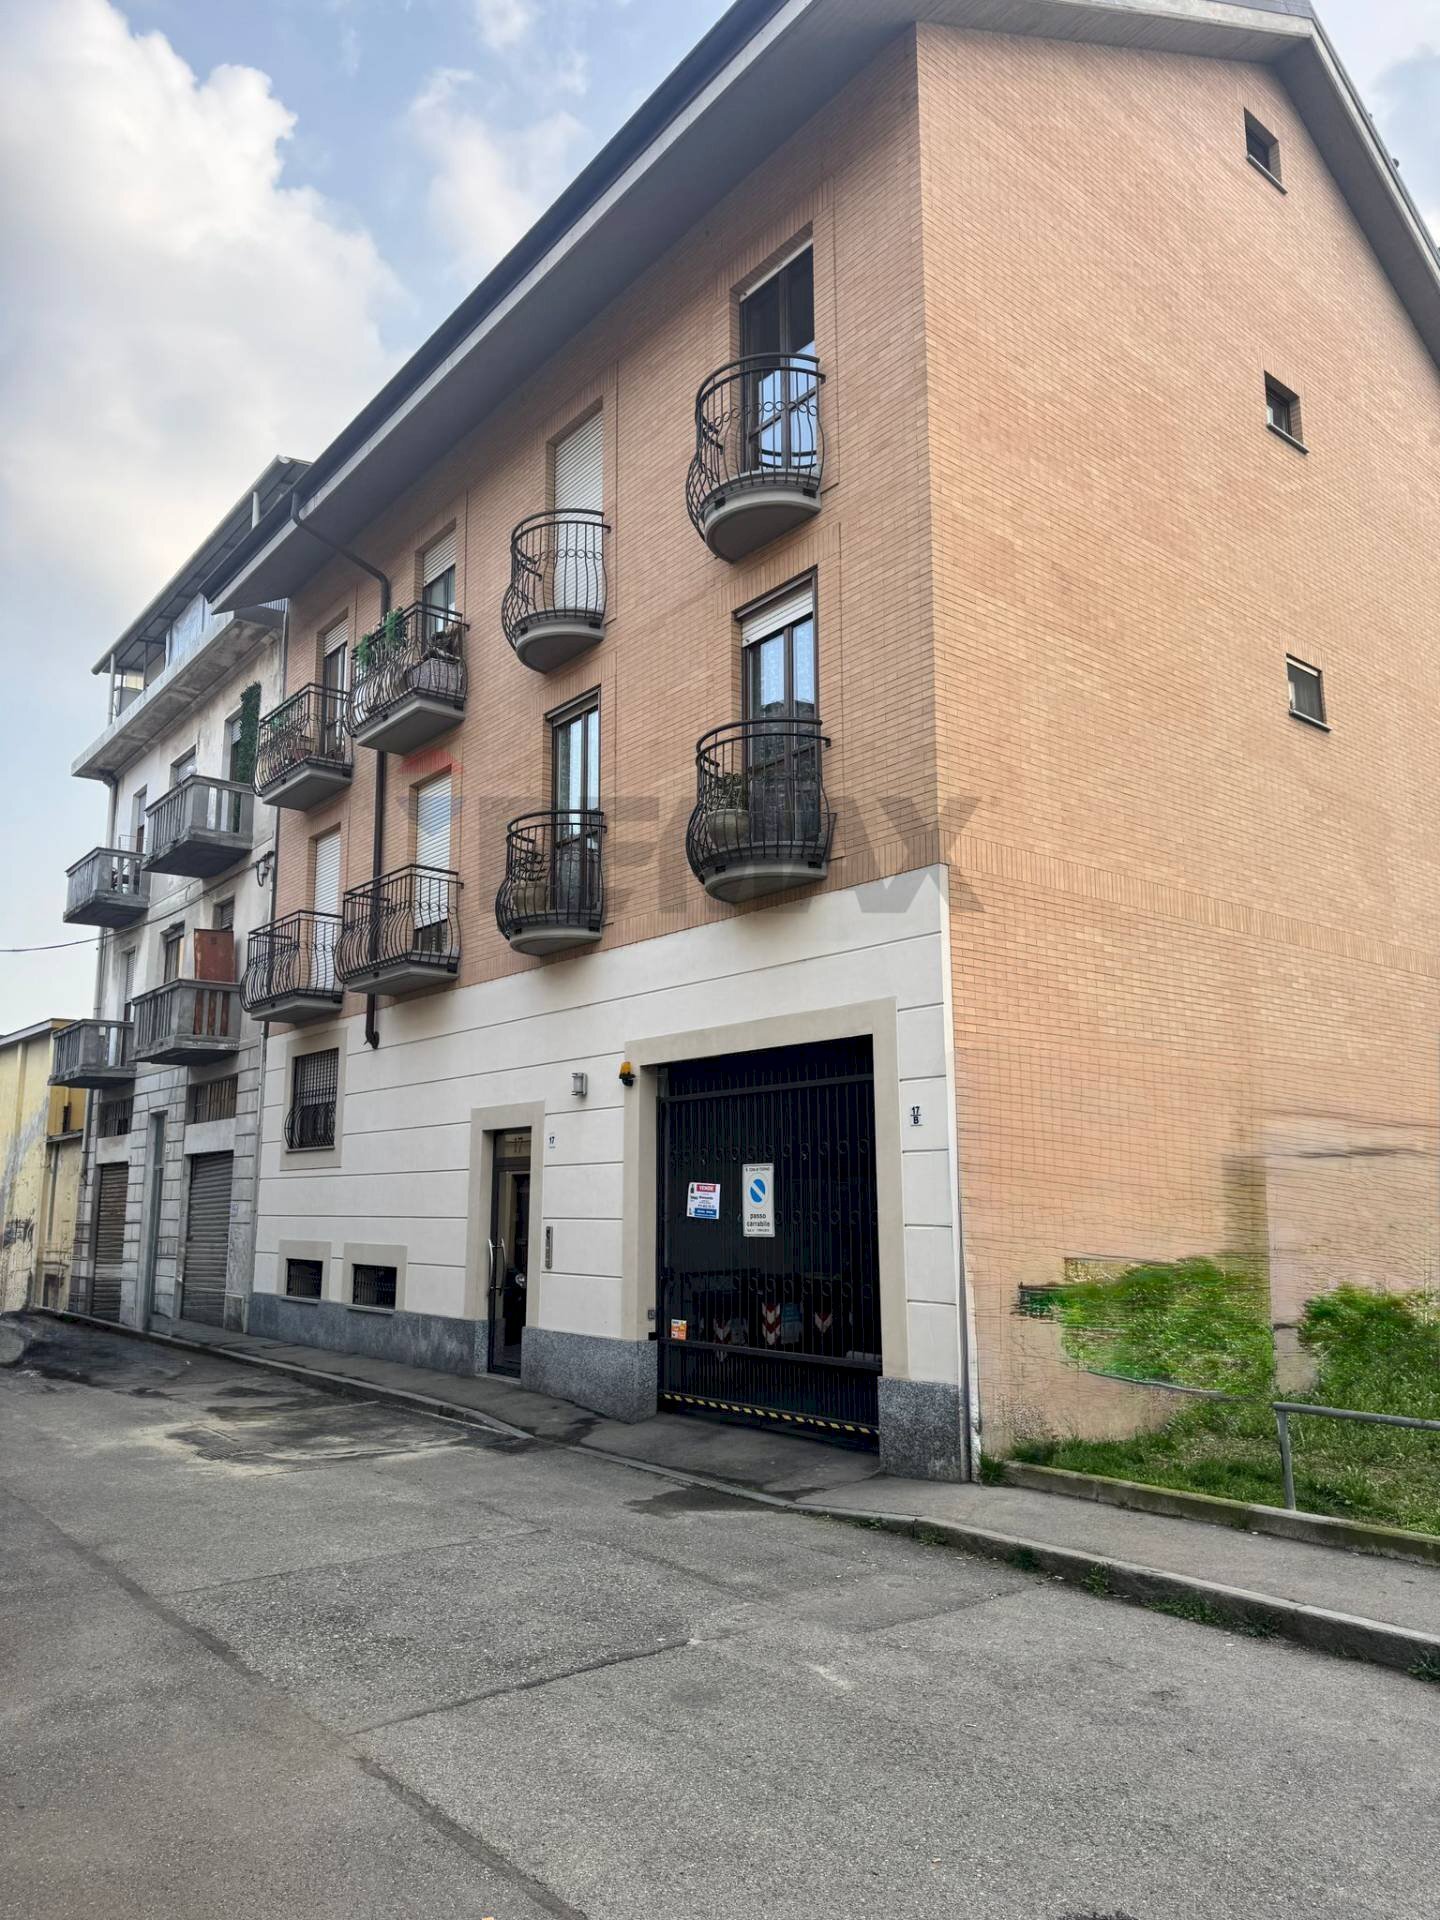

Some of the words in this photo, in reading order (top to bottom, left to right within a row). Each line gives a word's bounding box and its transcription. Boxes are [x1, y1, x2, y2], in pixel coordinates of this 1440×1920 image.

[911, 1105, 920, 1115] 17
[913, 1116, 919, 1124] B
[549, 1136, 556, 1145] 17
